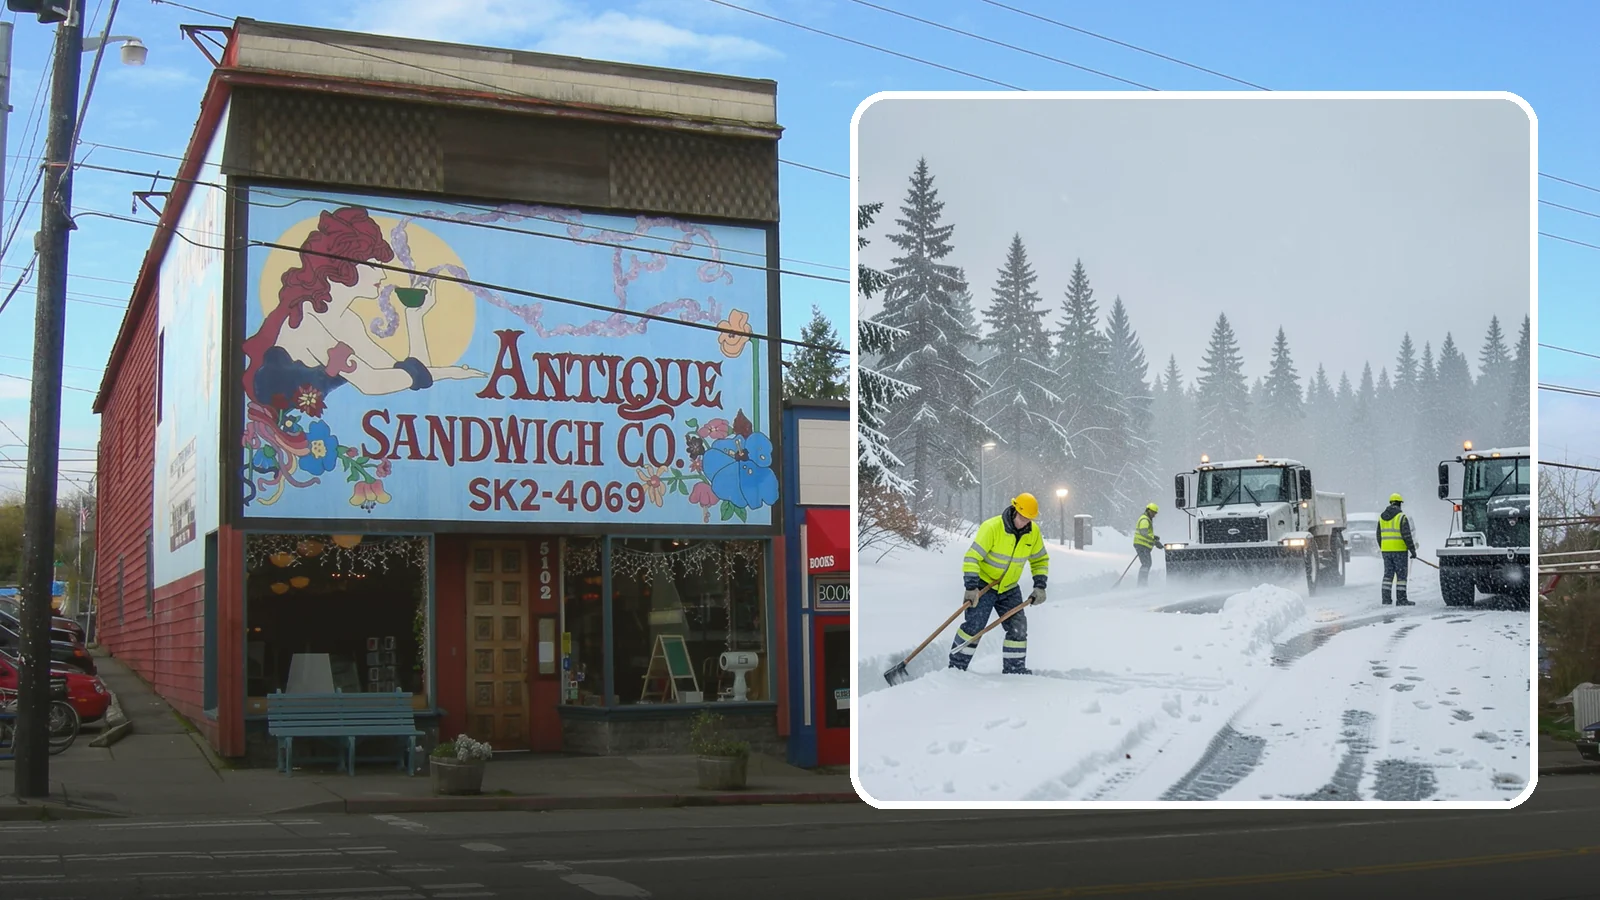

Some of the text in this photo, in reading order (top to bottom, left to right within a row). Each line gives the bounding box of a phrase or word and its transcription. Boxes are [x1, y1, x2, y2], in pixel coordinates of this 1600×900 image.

[476, 329, 723, 421] ANTIQUE
[361, 409, 685, 469] SANDWICH CO.
[469, 478, 646, 513] SK2-4069
[539, 542, 552, 600] 5102
[809, 555, 835, 569] BOOKS
